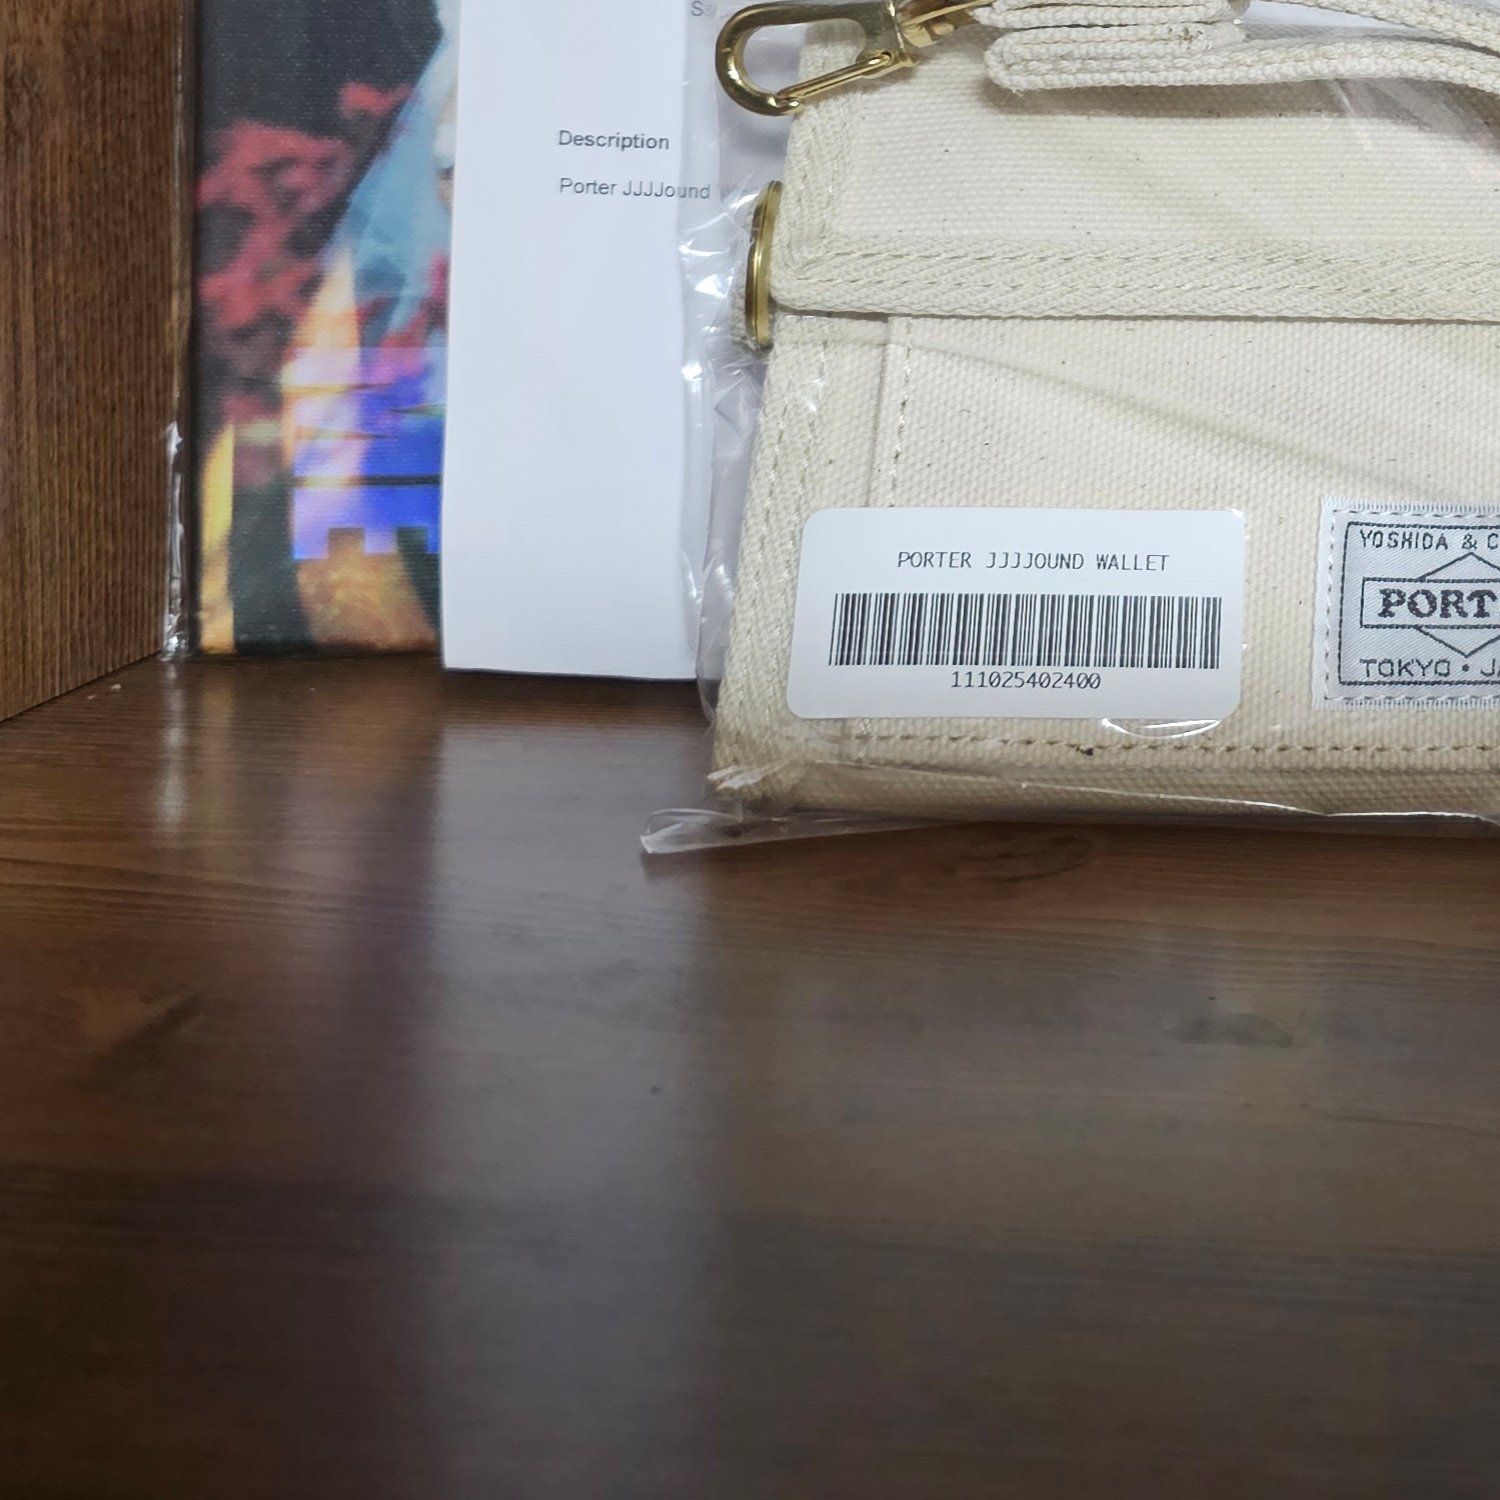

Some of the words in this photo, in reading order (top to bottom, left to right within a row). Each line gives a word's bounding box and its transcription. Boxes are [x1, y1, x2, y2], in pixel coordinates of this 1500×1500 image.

[558, 130, 669, 151] Description
[560, 178, 617, 195] Porter
[622, 180, 710, 199] JJJJound
[1360, 529, 1449, 549] YOSHIDA
[1462, 533, 1477, 549] &
[898, 551, 972, 568] PORTER
[986, 552, 1084, 570] JJJJOUND
[1096, 553, 1170, 571] WALLET
[1360, 658, 1451, 677] TOKYO
[951, 671, 1101, 689] 111025402400
